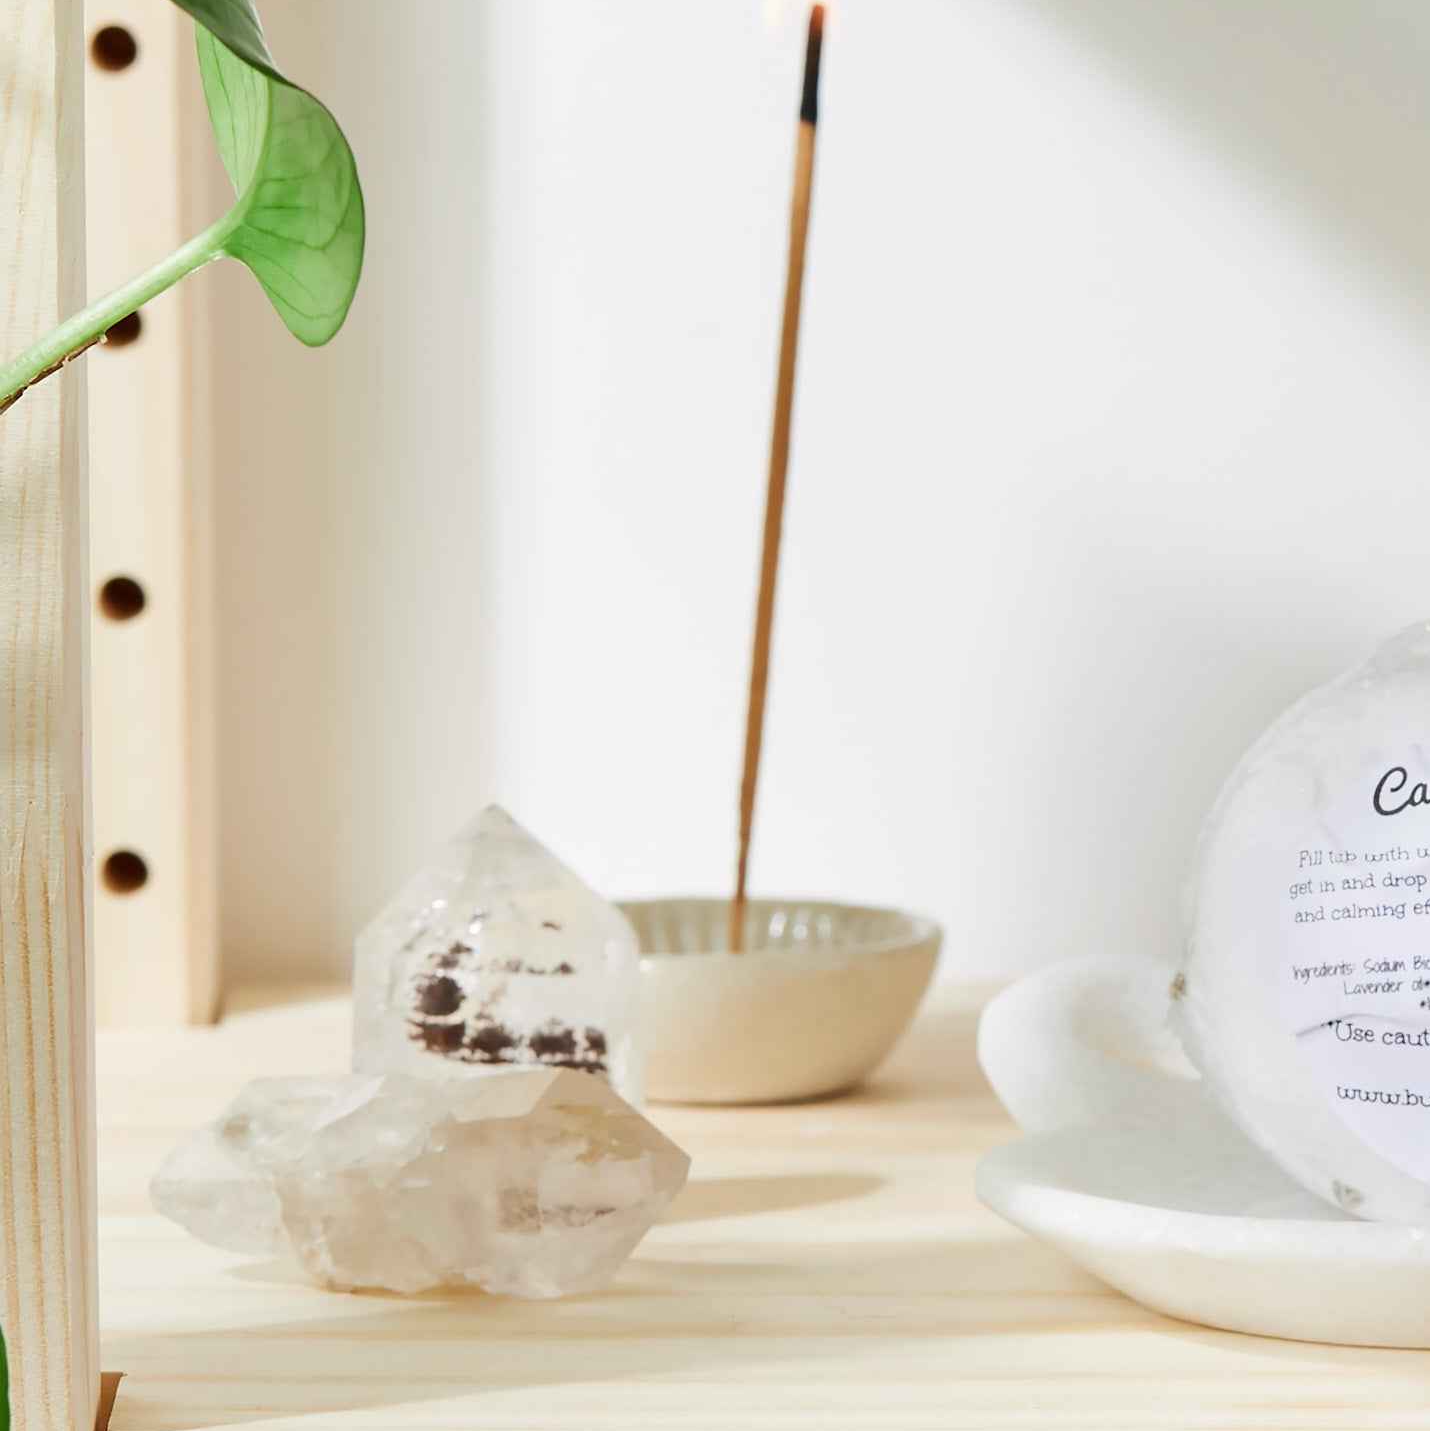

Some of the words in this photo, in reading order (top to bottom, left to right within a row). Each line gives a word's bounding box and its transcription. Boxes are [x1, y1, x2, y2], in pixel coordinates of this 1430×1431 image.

[1298, 849, 1323, 868] Fill
[1364, 847, 1410, 863] with
[1288, 878, 1313, 900] get
[1319, 880, 1336, 893] in
[1341, 873, 1376, 891] and
[1382, 872, 1428, 893] drop
[1294, 906, 1326, 924] and
[1331, 900, 1407, 920] calming
[1363, 957, 1406, 974] Sodium
[1343, 980, 1404, 996] Lavender
